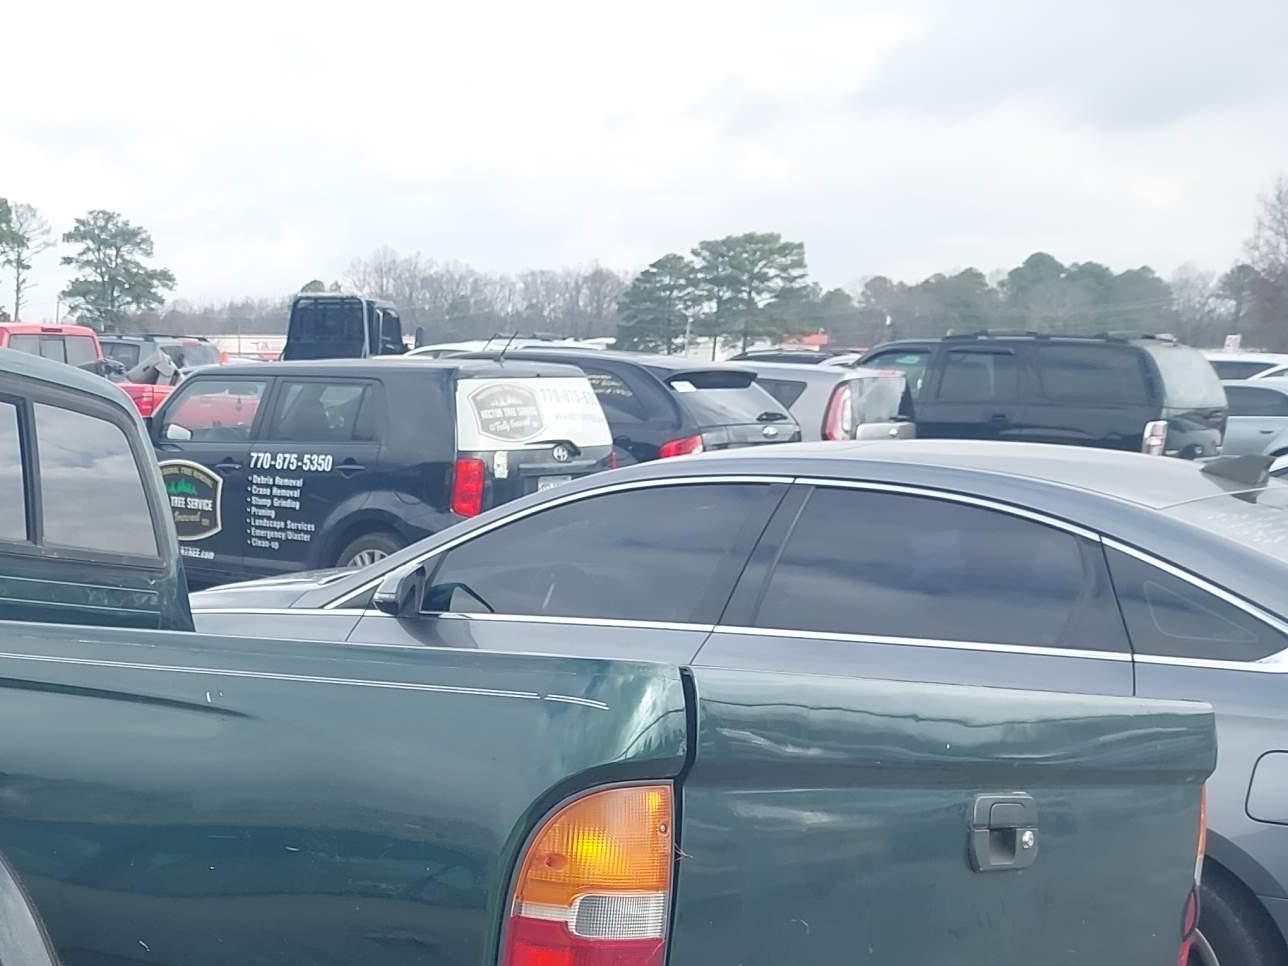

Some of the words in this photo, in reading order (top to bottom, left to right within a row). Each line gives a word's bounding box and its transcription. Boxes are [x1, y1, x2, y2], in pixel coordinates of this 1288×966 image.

[249, 452, 333, 471] 770-875-5350
[252, 474, 274, 485] Debris
[274, 476, 303, 488] Removal
[252, 485, 271, 495] Crane
[271, 486, 300, 498] Removal
[170, 496, 186, 508] TREE
[186, 497, 213, 511] SERVICE
[252, 496, 272, 508] Stump
[272, 498, 300, 511] Grinding
[251, 506, 276, 519] Pruning
[252, 516, 285, 530] Landscape
[286, 519, 316, 532] Services
[251, 537, 280, 550] Clean-up
